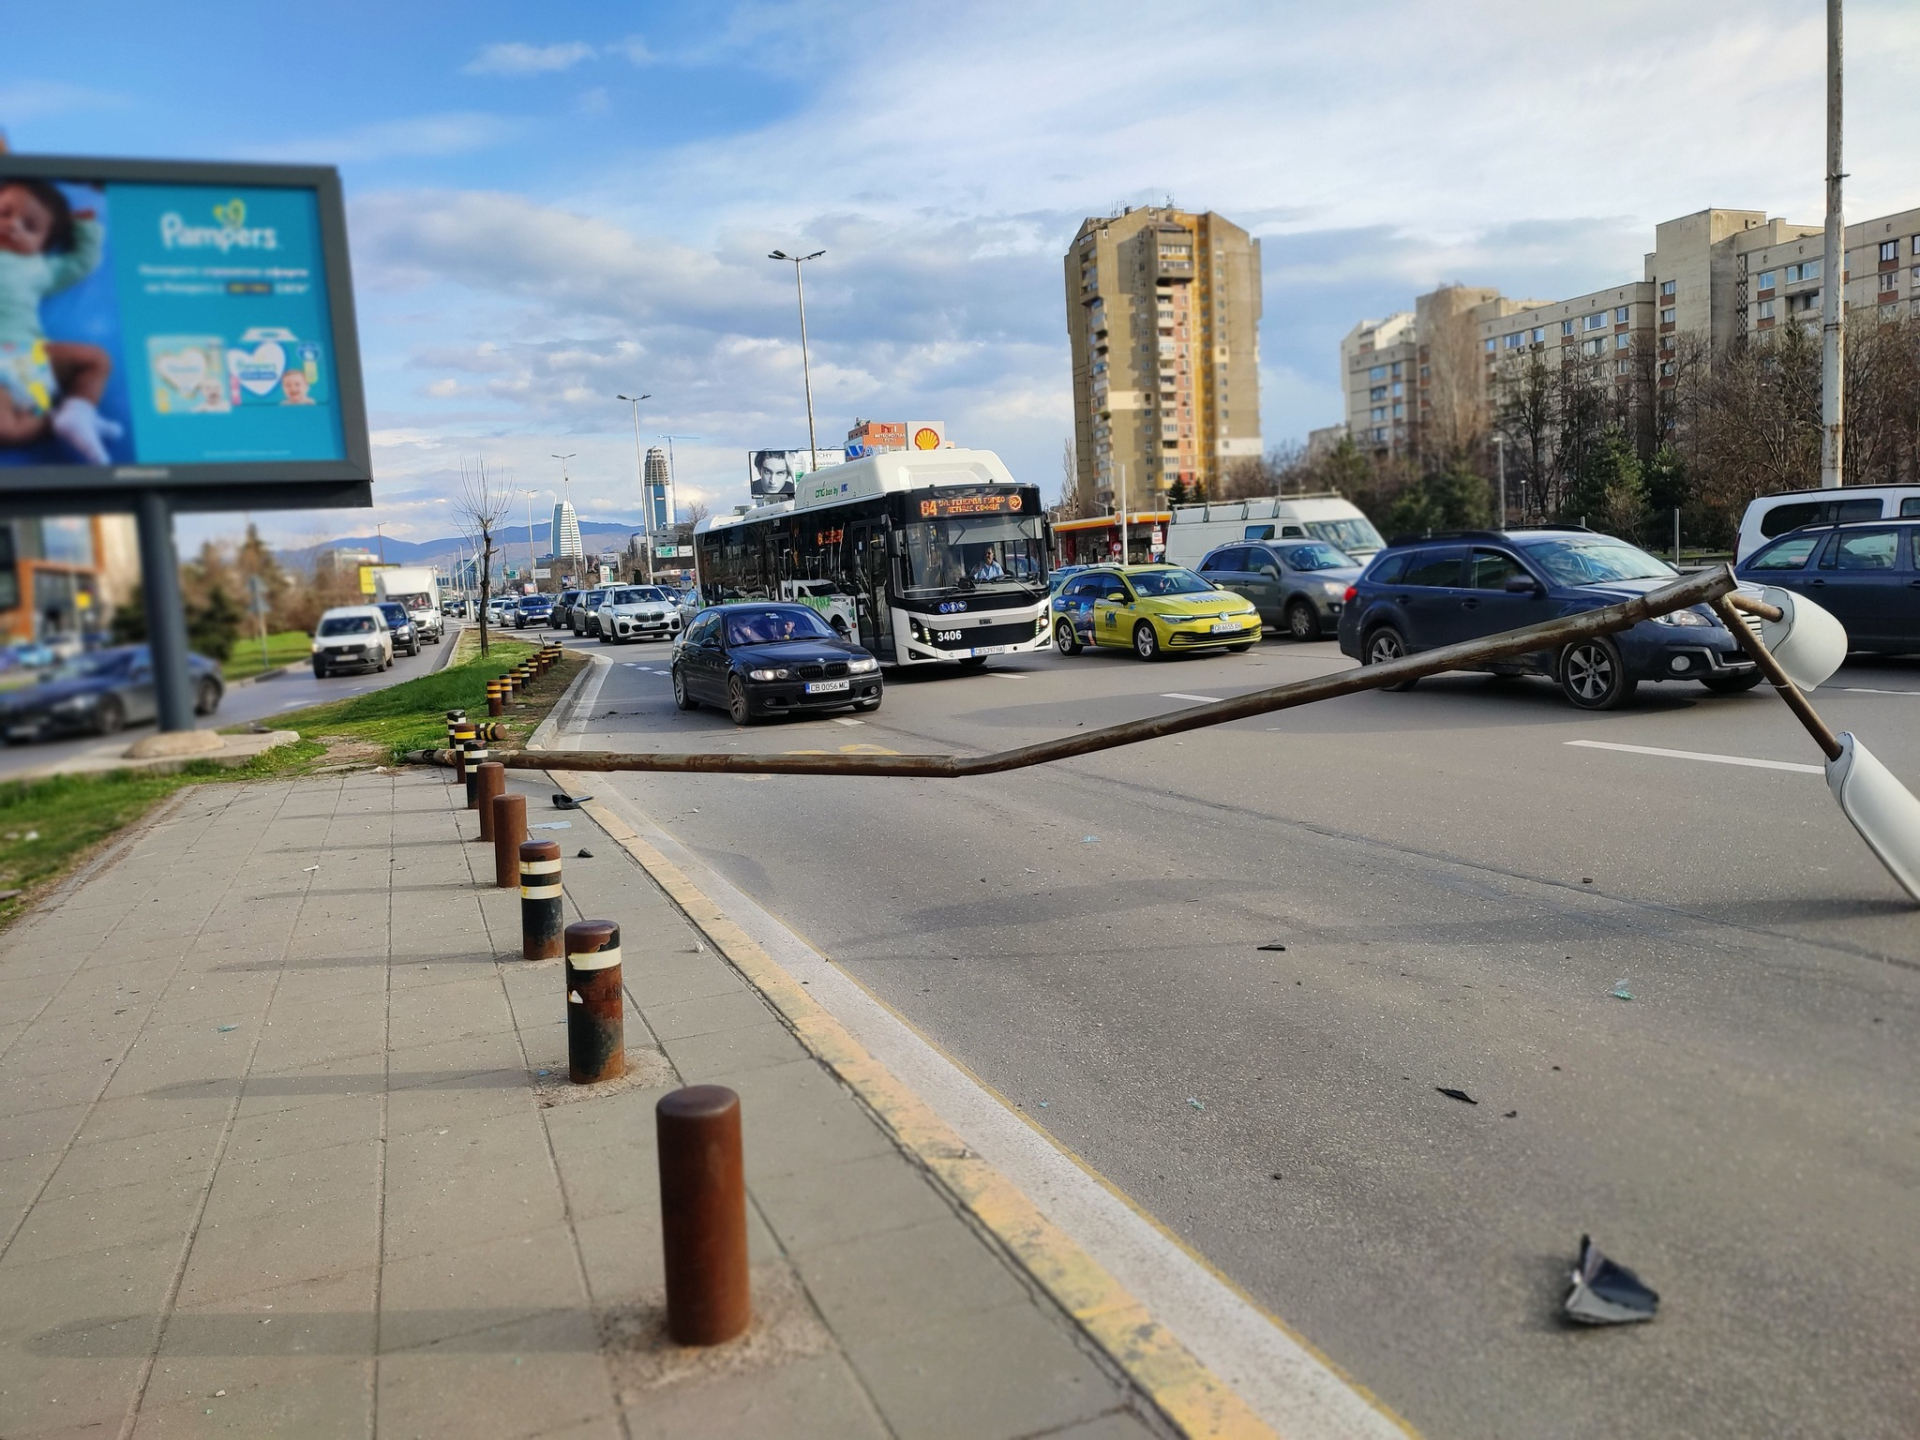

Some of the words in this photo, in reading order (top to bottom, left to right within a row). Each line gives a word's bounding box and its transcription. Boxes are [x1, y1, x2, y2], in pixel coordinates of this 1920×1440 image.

[160, 212, 278, 253] Pampers
[937, 630, 962, 642] 3406
[811, 684, 820, 692] CB
[821, 682, 838, 691] 0056
